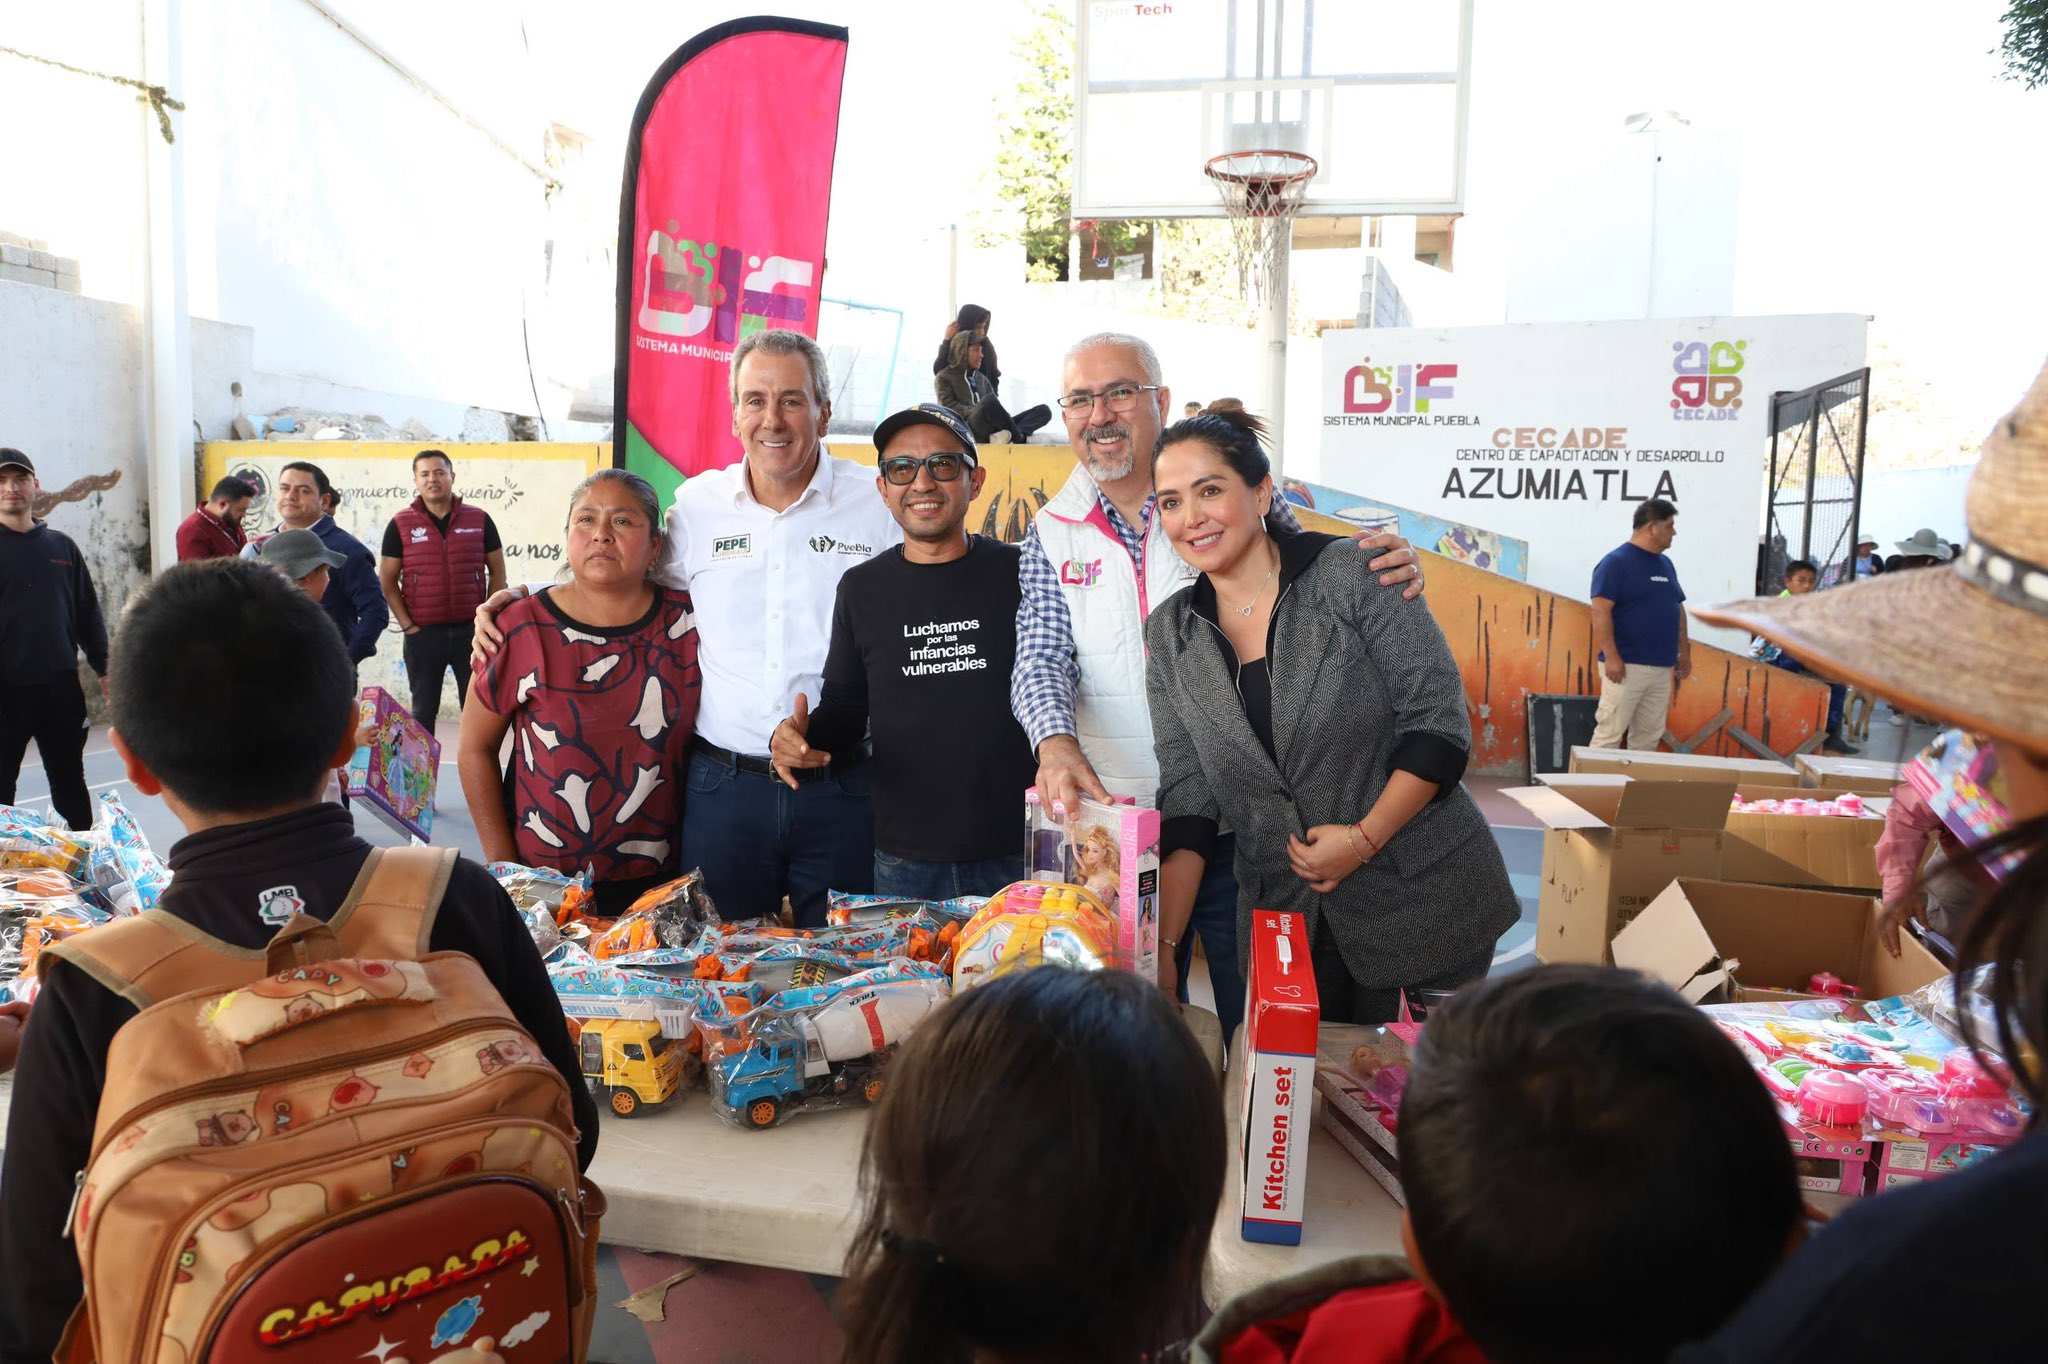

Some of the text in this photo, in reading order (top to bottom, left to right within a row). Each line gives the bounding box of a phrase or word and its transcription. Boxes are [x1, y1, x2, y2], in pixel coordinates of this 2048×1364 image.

[1134, 3, 1172, 15] Tech
[681, 343, 735, 363] MUNICIP
[1323, 415, 1481, 426] SISTEMA MUNICIPAL PUEBLA
[1673, 408, 1738, 421] CECADE
[1492, 427, 1627, 449] CECADE
[1456, 449, 1505, 460] CENTRO
[1509, 449, 1525, 460] DE
[1624, 450, 1632, 461] Y
[1636, 451, 1724, 462] DESARROLLO
[1442, 467, 1678, 502] AZUMIATLA
[715, 537, 747, 553] PEPE
[904, 619, 980, 637] Luchamos
[927, 634, 958, 646] por las
[910, 643, 976, 661] infancias
[902, 657, 987, 677] vulnerables
[1122, 825, 1137, 935] CHARM GIRL
[264, 888, 294, 903] LMB
[1266, 919, 1278, 928] set
[1280, 914, 1292, 934] Kitchen
[1263, 1066, 1292, 1210] Kitchen set
